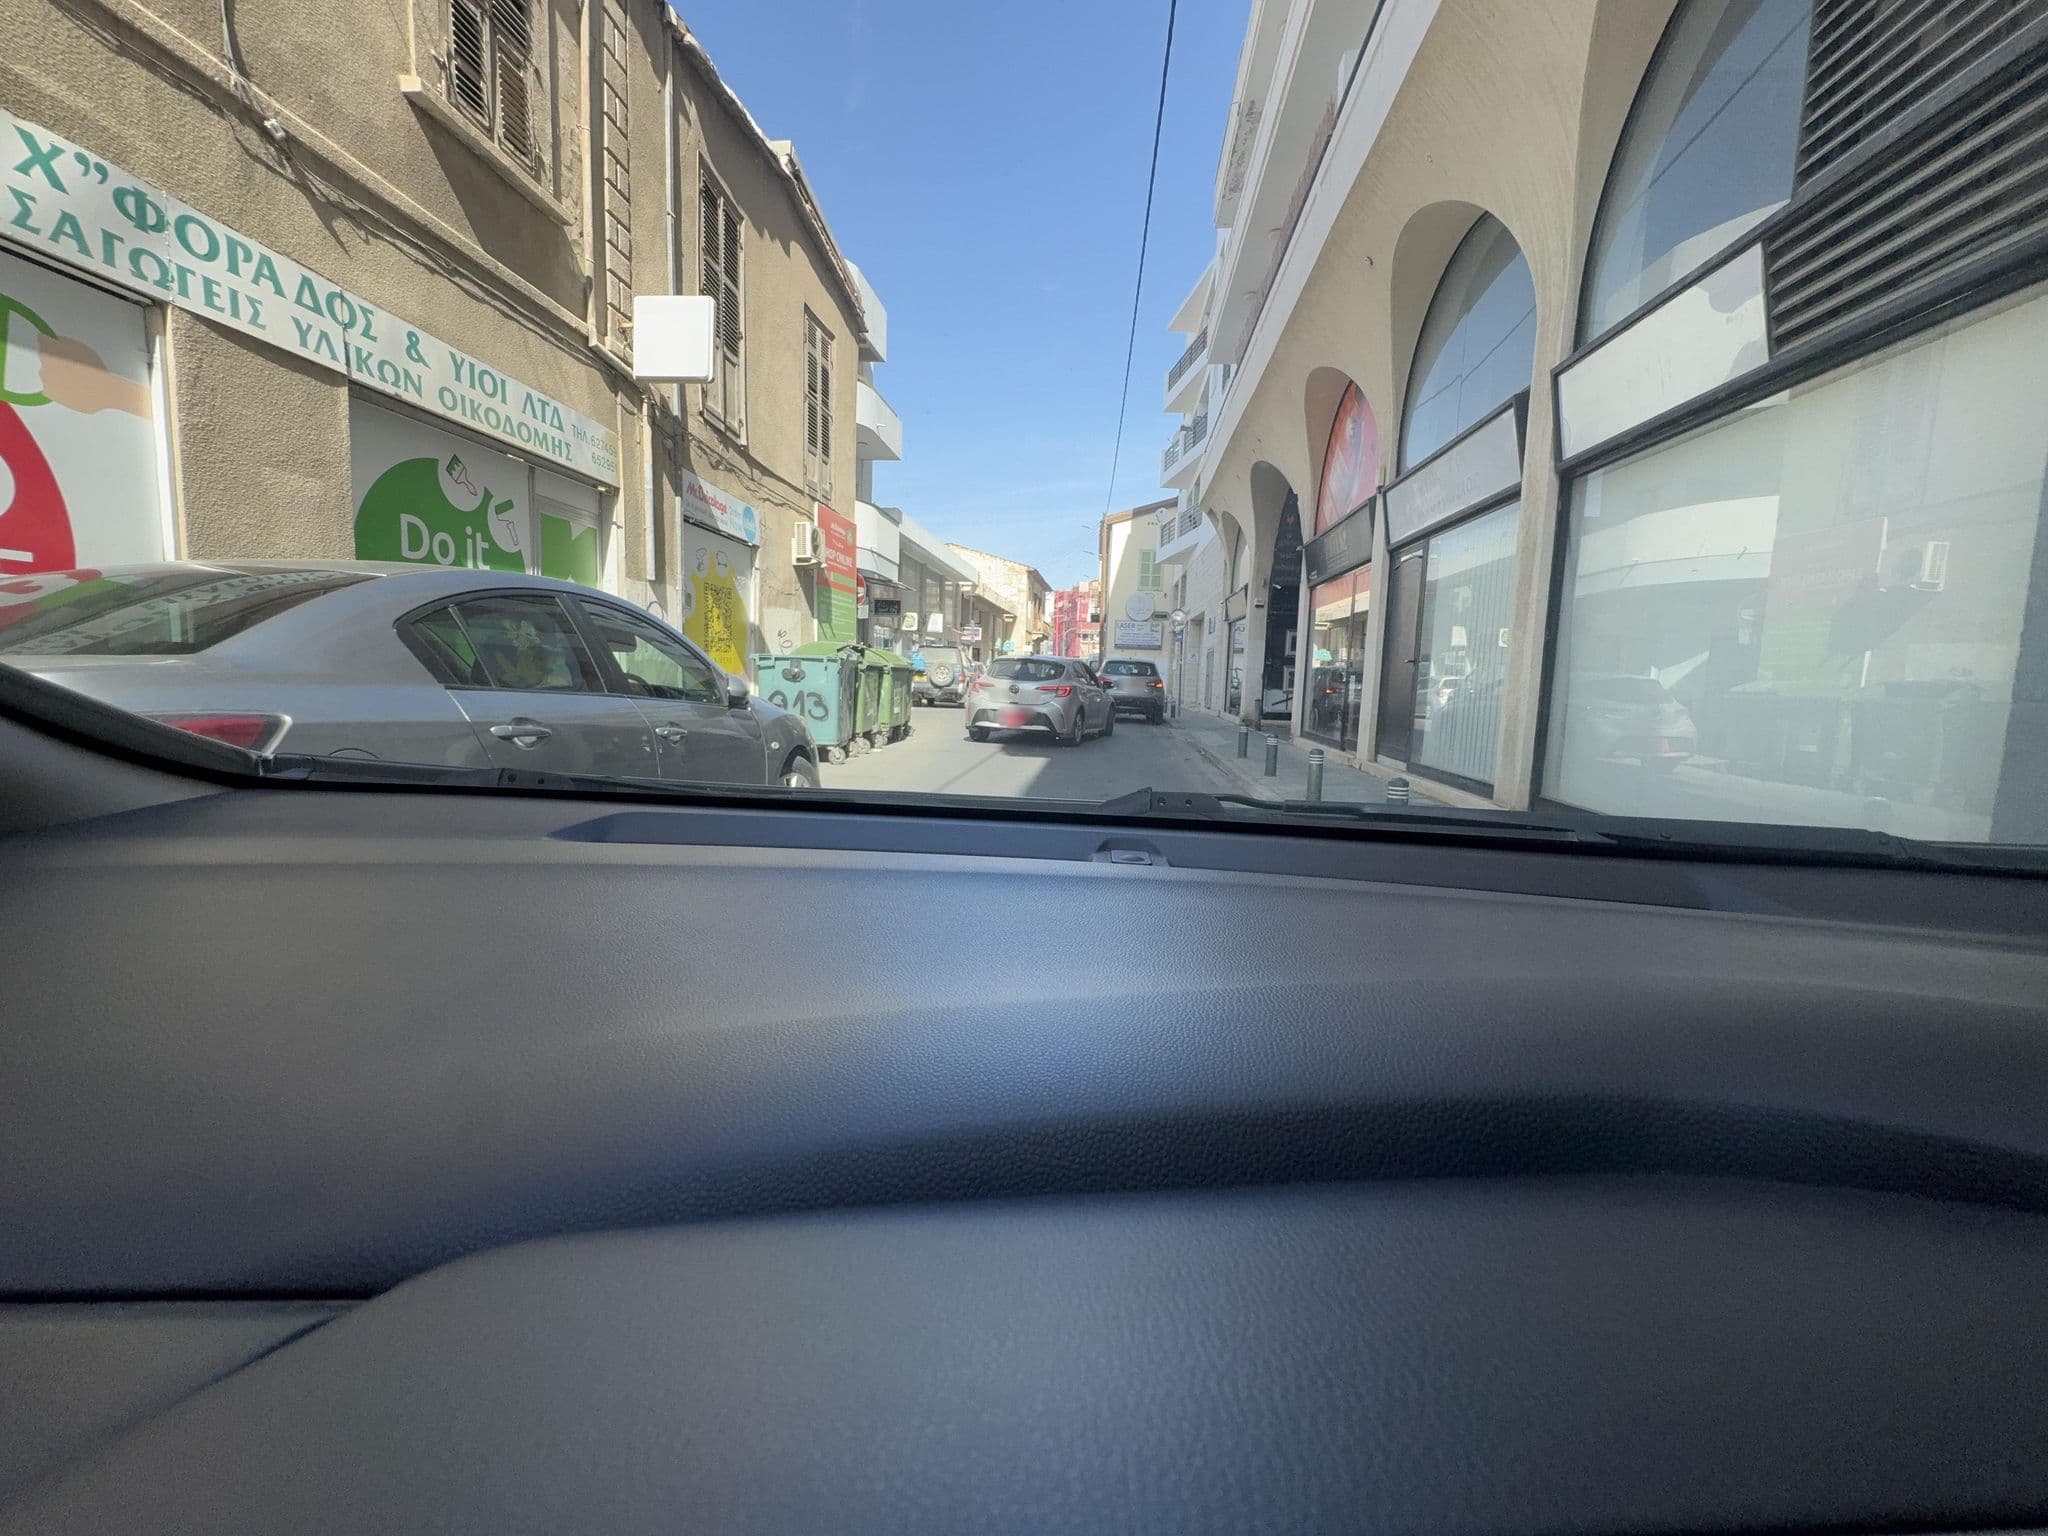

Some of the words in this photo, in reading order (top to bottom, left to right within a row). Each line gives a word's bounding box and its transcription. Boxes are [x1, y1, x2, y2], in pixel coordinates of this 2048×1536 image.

[290, 315, 422, 398] ΥΛΙΚΩΝ
[439, 386, 573, 462] ΟΙΚΟΔΟΜΗΣ
[406, 331, 431, 369] &
[449, 350, 508, 405] ΥΙΟΙ
[522, 391, 565, 432] ΛΤΔ
[401, 513, 456, 565] Do
[466, 526, 490, 570] it
